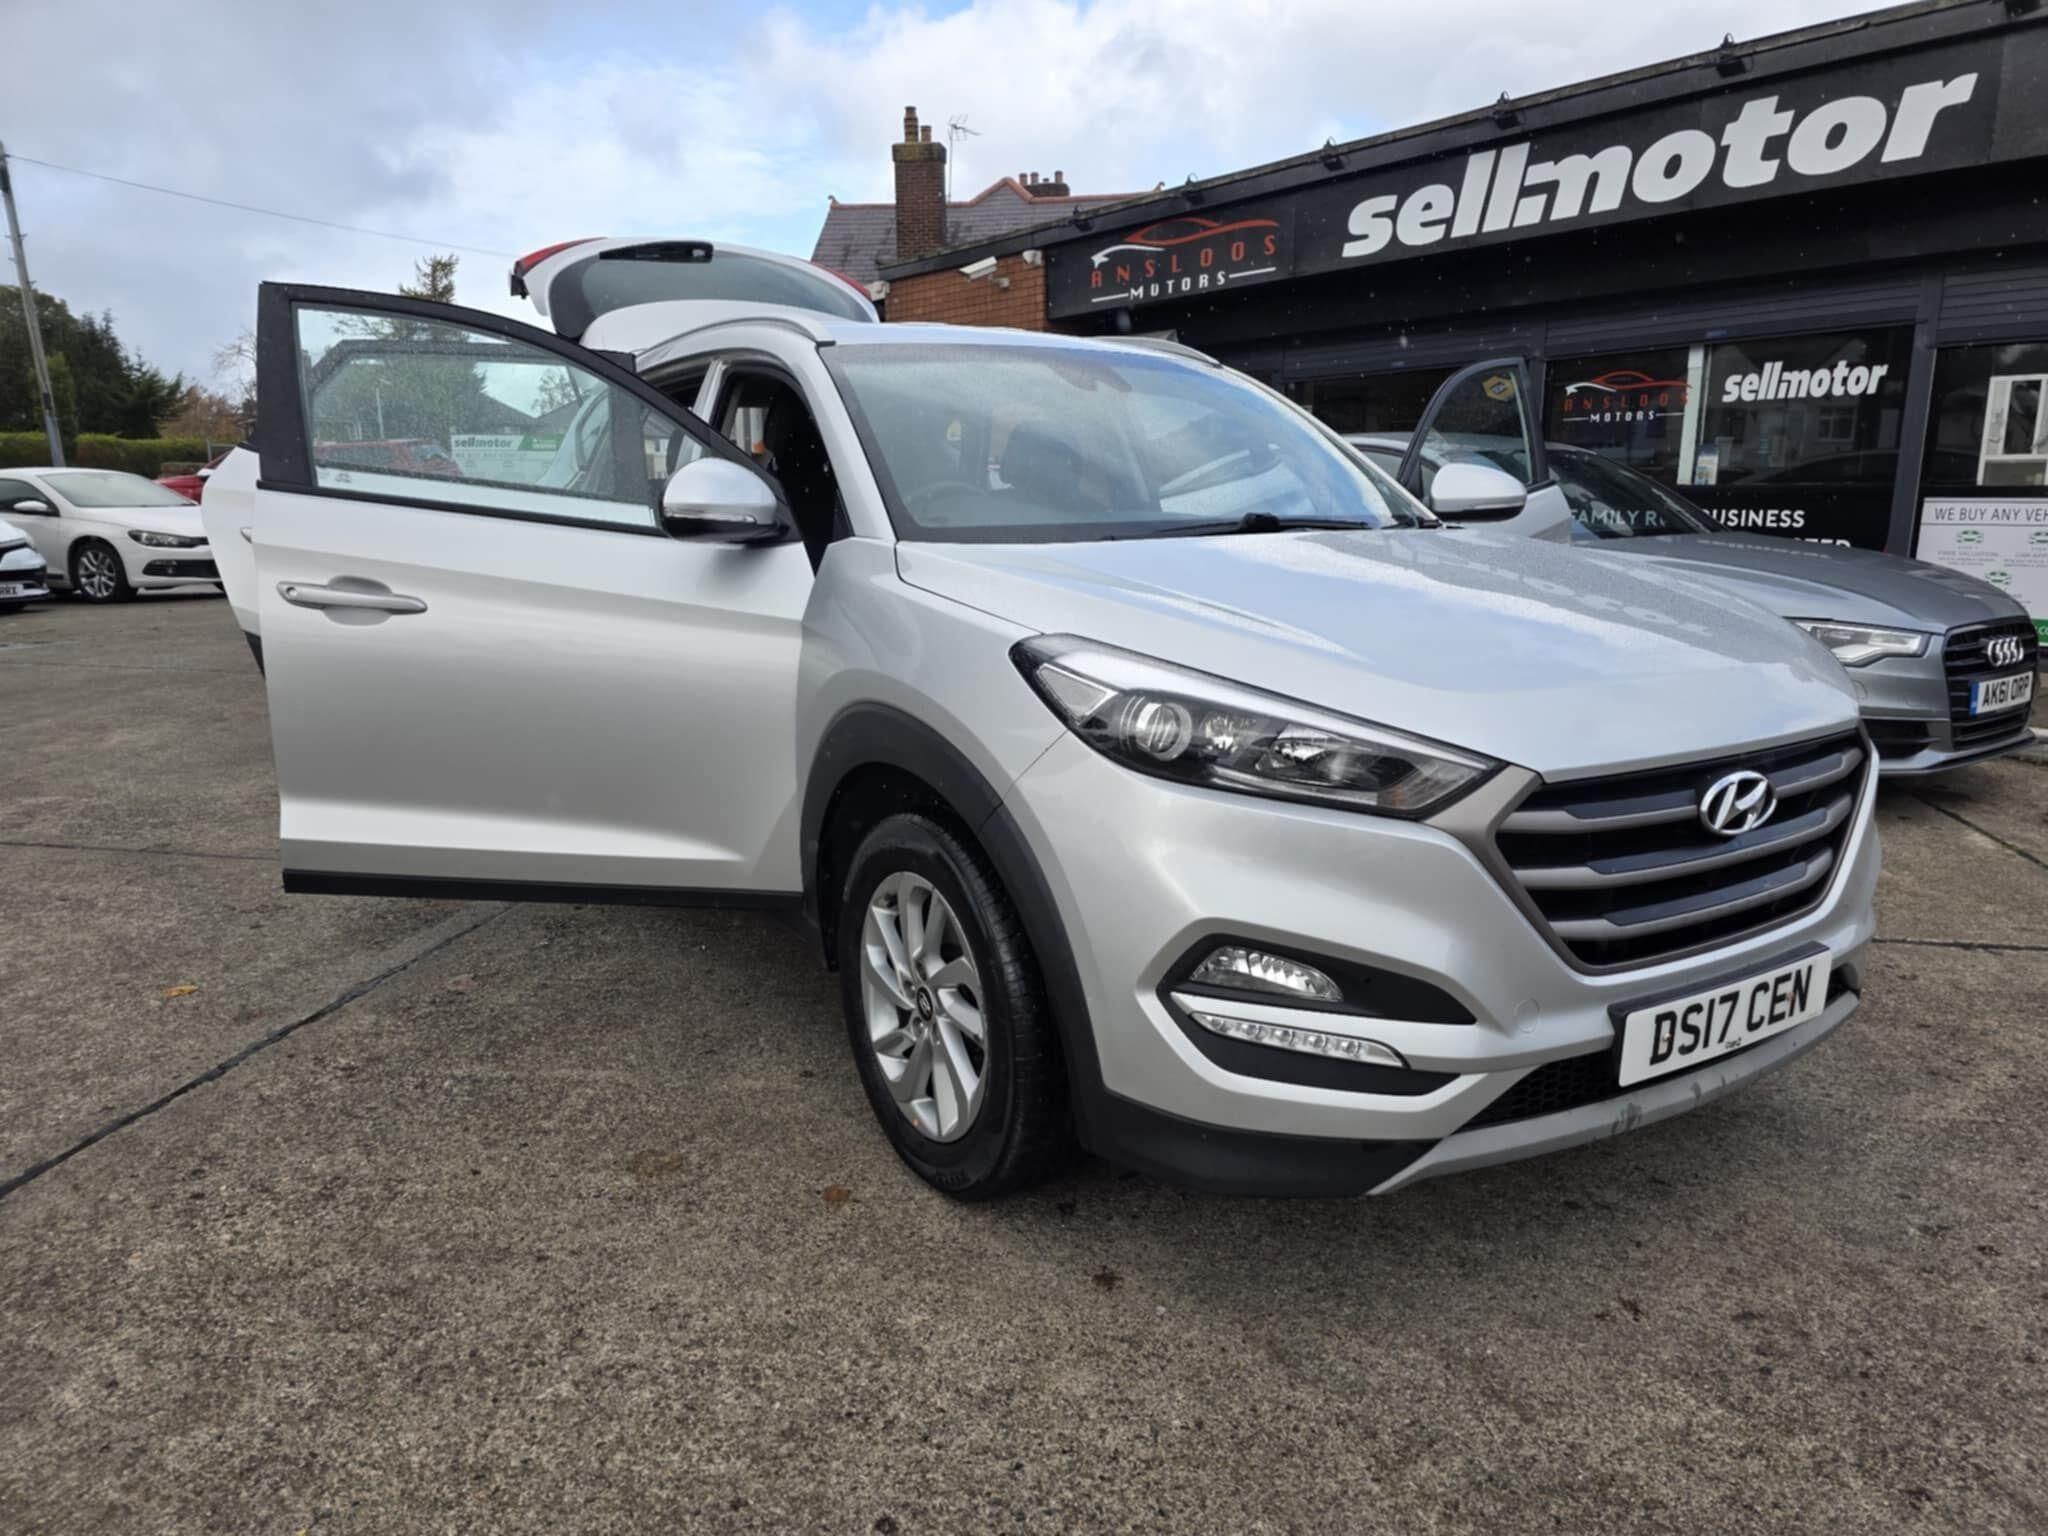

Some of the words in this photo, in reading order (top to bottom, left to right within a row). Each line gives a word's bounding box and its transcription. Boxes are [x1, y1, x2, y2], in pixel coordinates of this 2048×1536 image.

[1341, 72, 1978, 258] sellmotor
[1090, 234, 1276, 288] ANSLOOS
[1722, 360, 1888, 402] sellmotor
[1590, 410, 1655, 423] MOTORS
[1703, 508, 1806, 529] USINESS
[1935, 508, 1955, 520] WE
[1960, 508, 1986, 521] BUY
[1991, 508, 2020, 521] ANY
[1650, 990, 1740, 1066] DS17
[1746, 965, 1813, 1032] CEN
